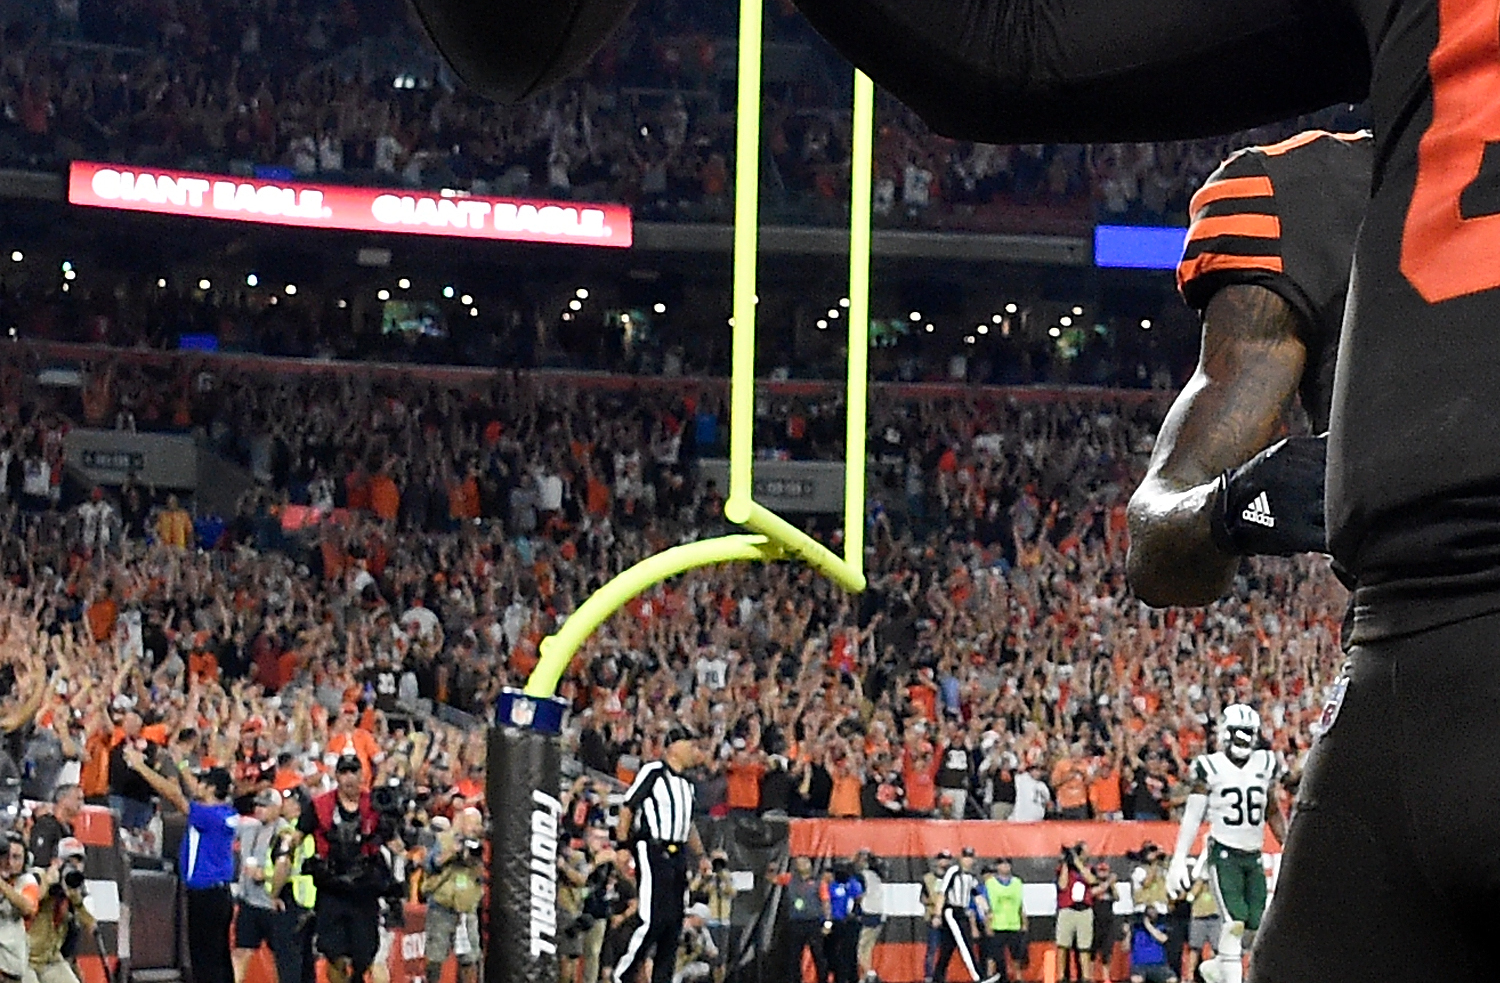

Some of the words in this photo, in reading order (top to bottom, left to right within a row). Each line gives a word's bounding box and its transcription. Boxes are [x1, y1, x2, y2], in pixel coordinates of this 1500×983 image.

[92, 169, 210, 208] GIANT
[371, 194, 492, 229] GIANT
[1242, 509, 1275, 528] adidas
[1220, 785, 1265, 826] 36
[530, 789, 563, 957] FOOTBALL
